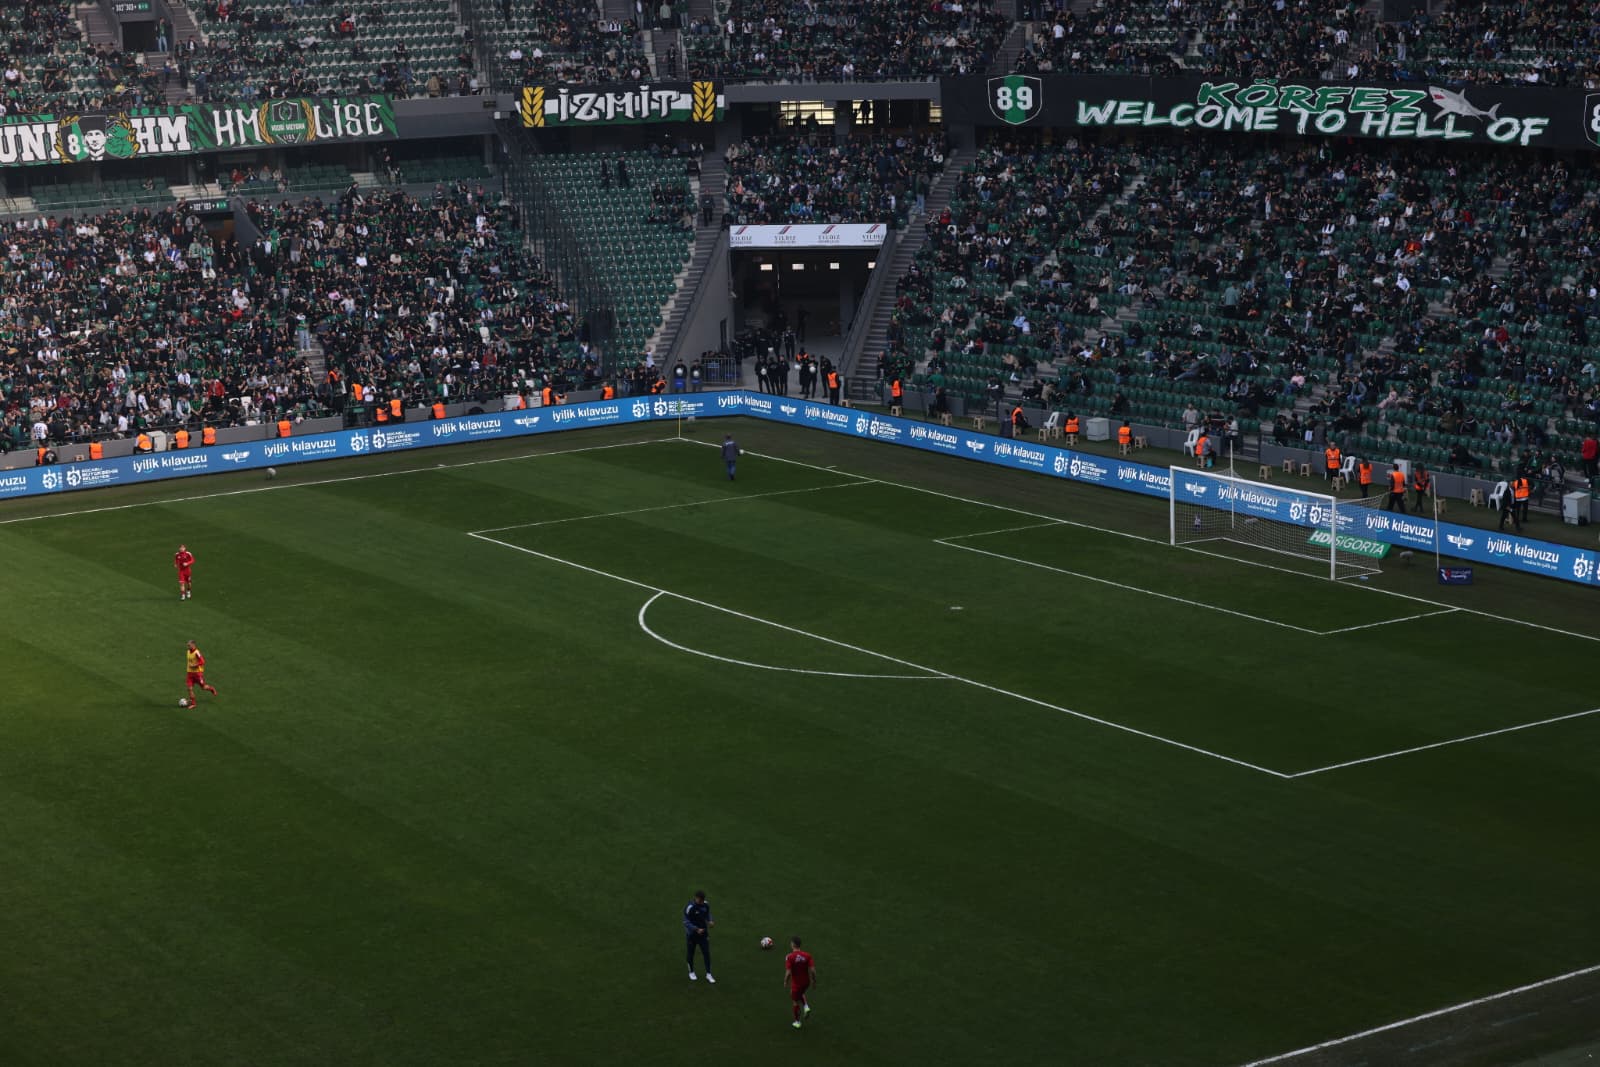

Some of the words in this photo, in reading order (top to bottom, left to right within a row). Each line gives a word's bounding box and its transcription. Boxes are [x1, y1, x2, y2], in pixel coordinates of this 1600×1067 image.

[558, 85, 681, 122] İZMİT
[997, 86, 1033, 111] 89
[1197, 77, 1428, 115] KÖRFEZ
[212, 107, 263, 146] HM
[312, 99, 384, 138] LİSE
[1077, 99, 1279, 131] WELCOME
[1290, 107, 1347, 135] TO
[1360, 111, 1474, 139] HELL
[1486, 116, 1550, 146] OF
[130, 115, 193, 154] HM
[717, 395, 744, 408] iyilik
[552, 407, 576, 423] iyilik
[577, 404, 619, 418] kılavuzu
[433, 421, 457, 437] iyilik
[459, 418, 501, 432] kılavuzu
[910, 425, 927, 439] iyilik
[928, 428, 958, 445] kılavuzu
[264, 442, 289, 457] iyilik
[291, 438, 336, 452] kılavuzu
[993, 441, 1012, 456] iyilik
[1013, 445, 1045, 461] kılavuzu
[133, 457, 159, 473] iyilik
[161, 453, 208, 468] kılavuzu
[1117, 465, 1137, 481] iyilik
[1240, 487, 1278, 507] kılavuzu
[1365, 513, 1390, 529] iyilik
[1391, 517, 1434, 538] kılavuzu
[1486, 537, 1512, 554] iyilik
[1514, 542, 1560, 563] kılavuzu
